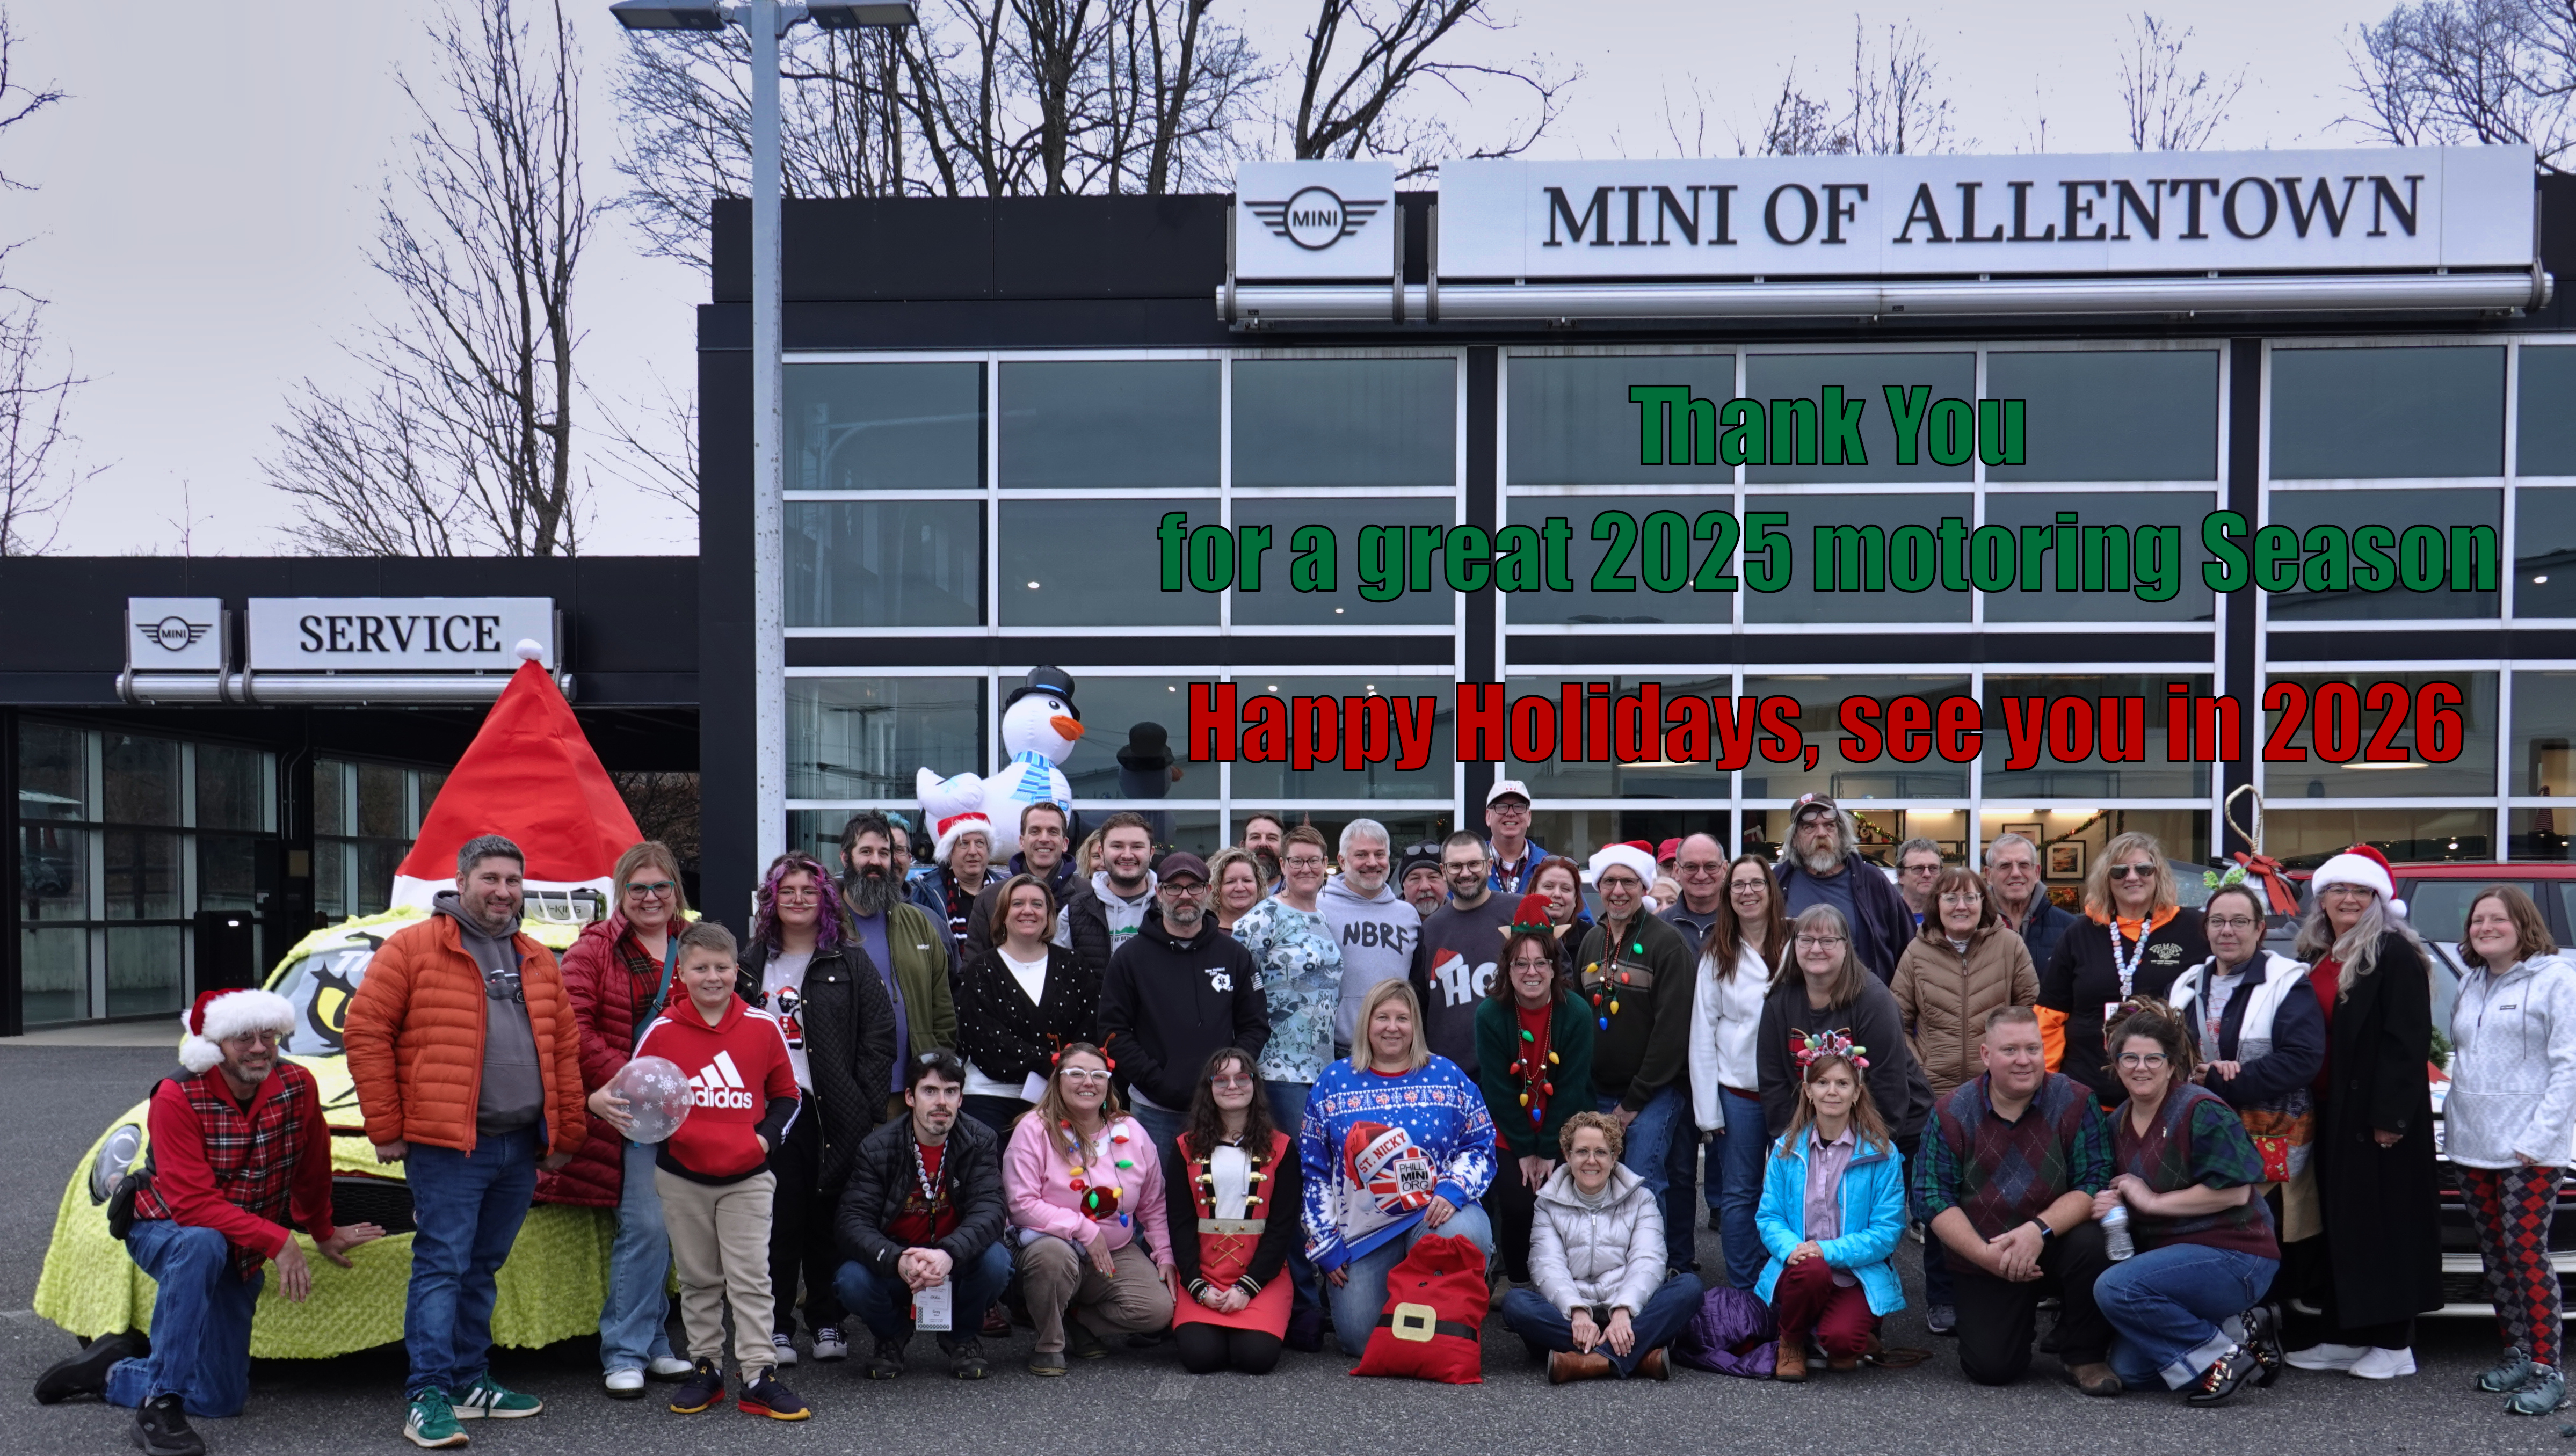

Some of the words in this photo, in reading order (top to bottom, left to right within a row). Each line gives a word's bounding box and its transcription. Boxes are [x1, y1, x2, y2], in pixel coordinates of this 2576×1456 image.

[1292, 210, 1338, 227] MINI
[1543, 185, 1738, 246] MINI
[1764, 184, 1868, 245] OF
[1893, 175, 2425, 243] ALLENTOWN
[161, 629, 187, 638] MINI
[300, 615, 500, 652] SERVICE
[333, 951, 375, 972] TI
[1358, 1157, 1376, 1174] ST.
[1372, 1131, 1406, 1160] NICKY
[1399, 1161, 1426, 1173] PHILLY
[1401, 1170, 1428, 1182] MINI
